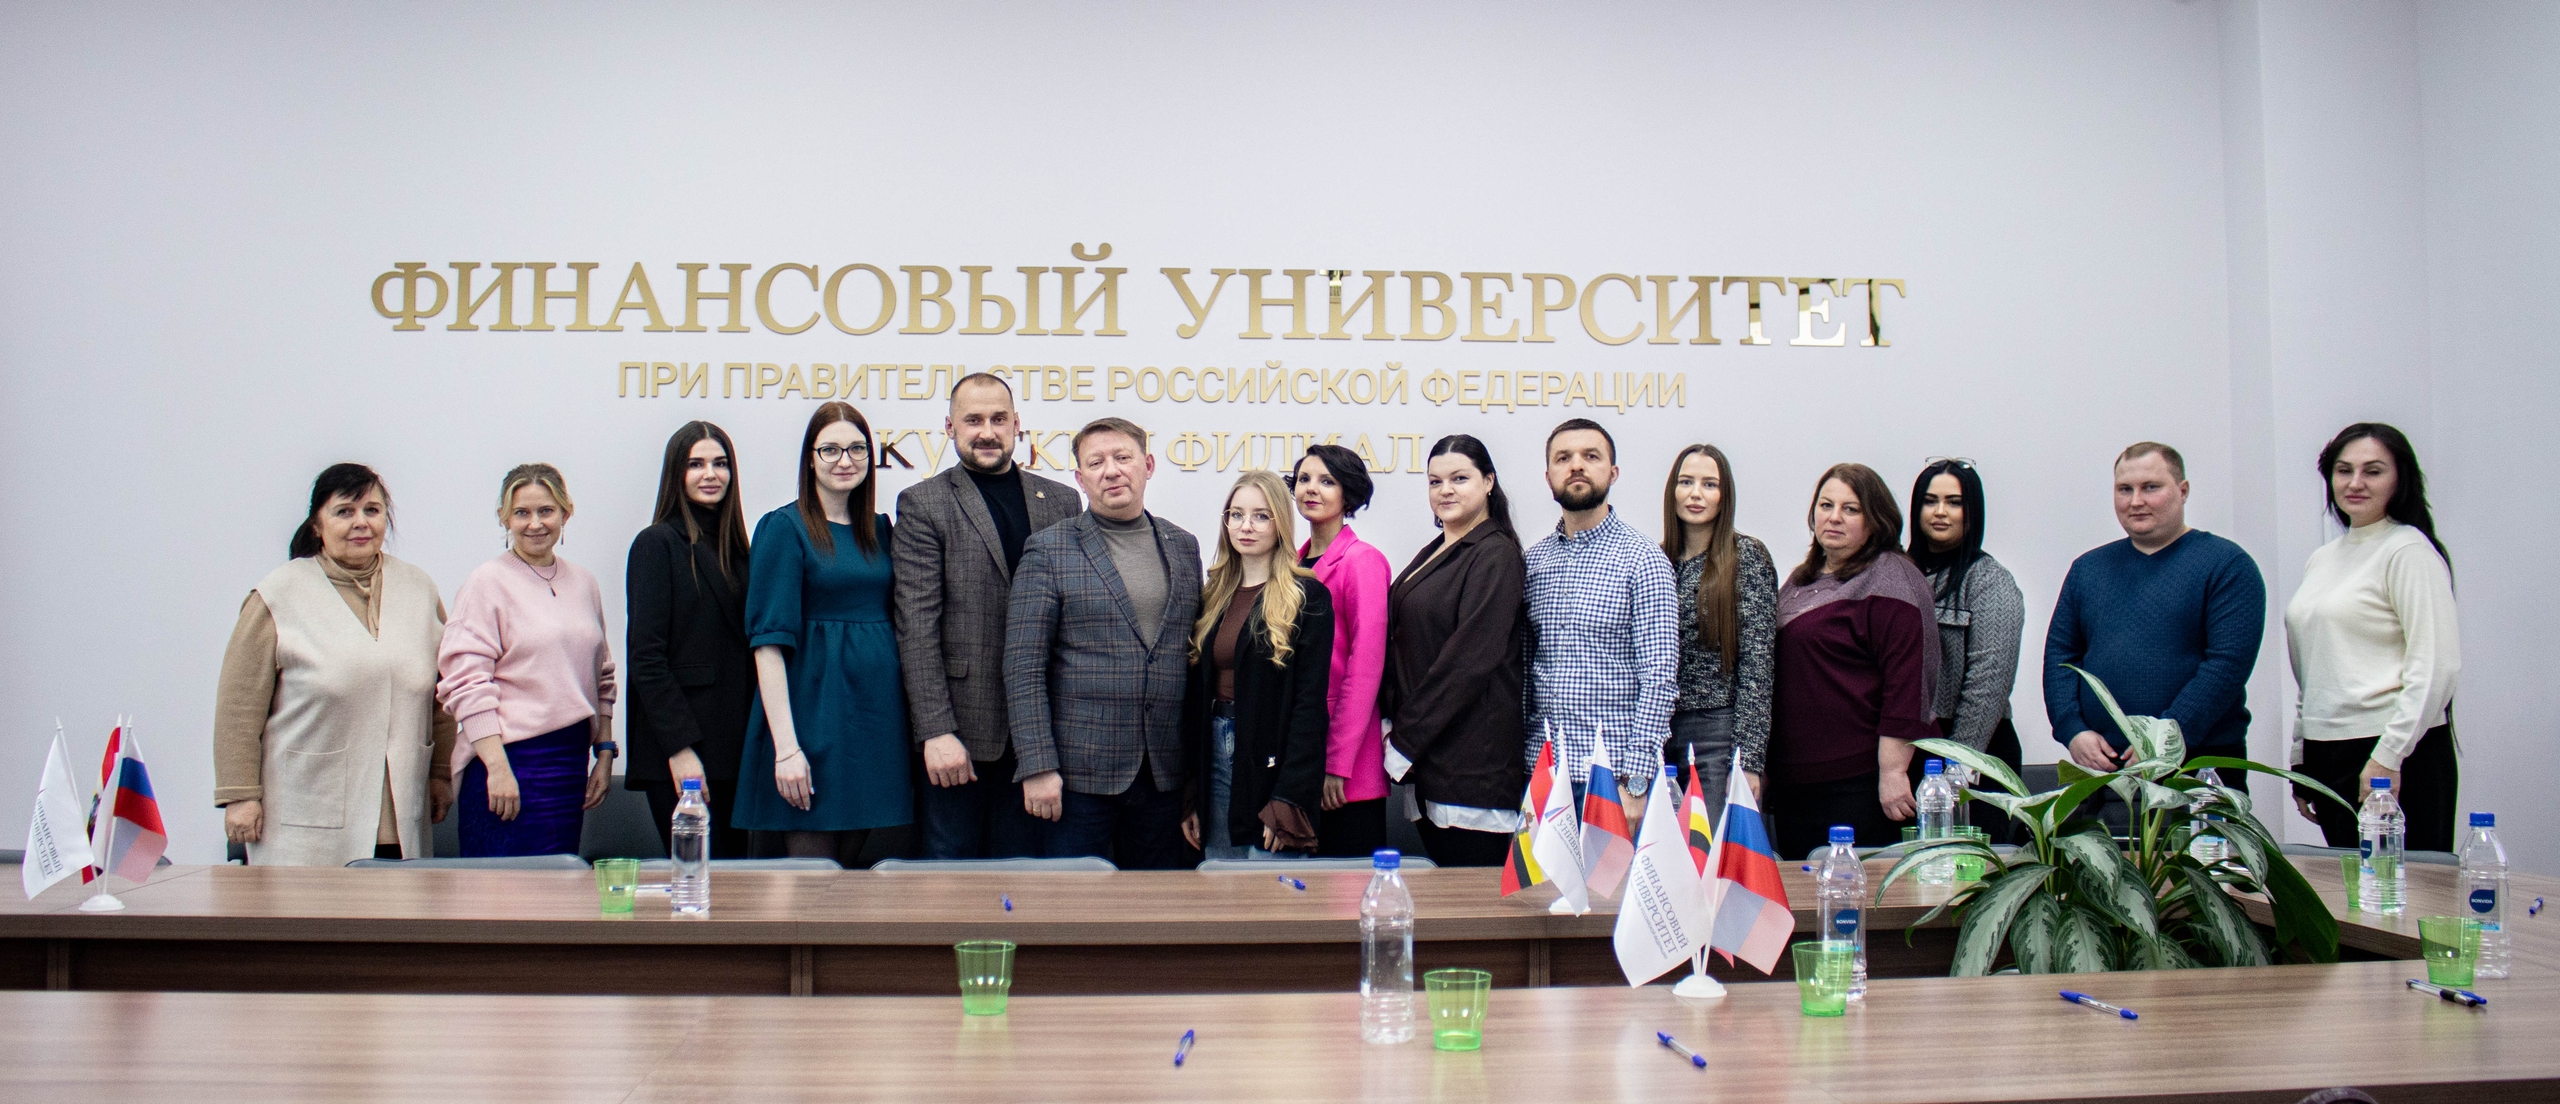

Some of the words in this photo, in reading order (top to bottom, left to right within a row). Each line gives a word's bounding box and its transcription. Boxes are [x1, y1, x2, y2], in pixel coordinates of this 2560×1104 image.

[371, 243, 1129, 337] ФИНАНСОВЫЙ
[1160, 268, 1907, 348] УНИВЕРСИТЕТ
[619, 362, 710, 400] ПРИ
[1109, 361, 1409, 407] РОССИЙСКОЙ
[1422, 369, 1686, 415] ФЕДЕРАЦИИ
[1632, 861, 1679, 954] УНИВЕРСИТЕТ
[1641, 854, 1689, 949] ФИНАНСОВЫЙ
